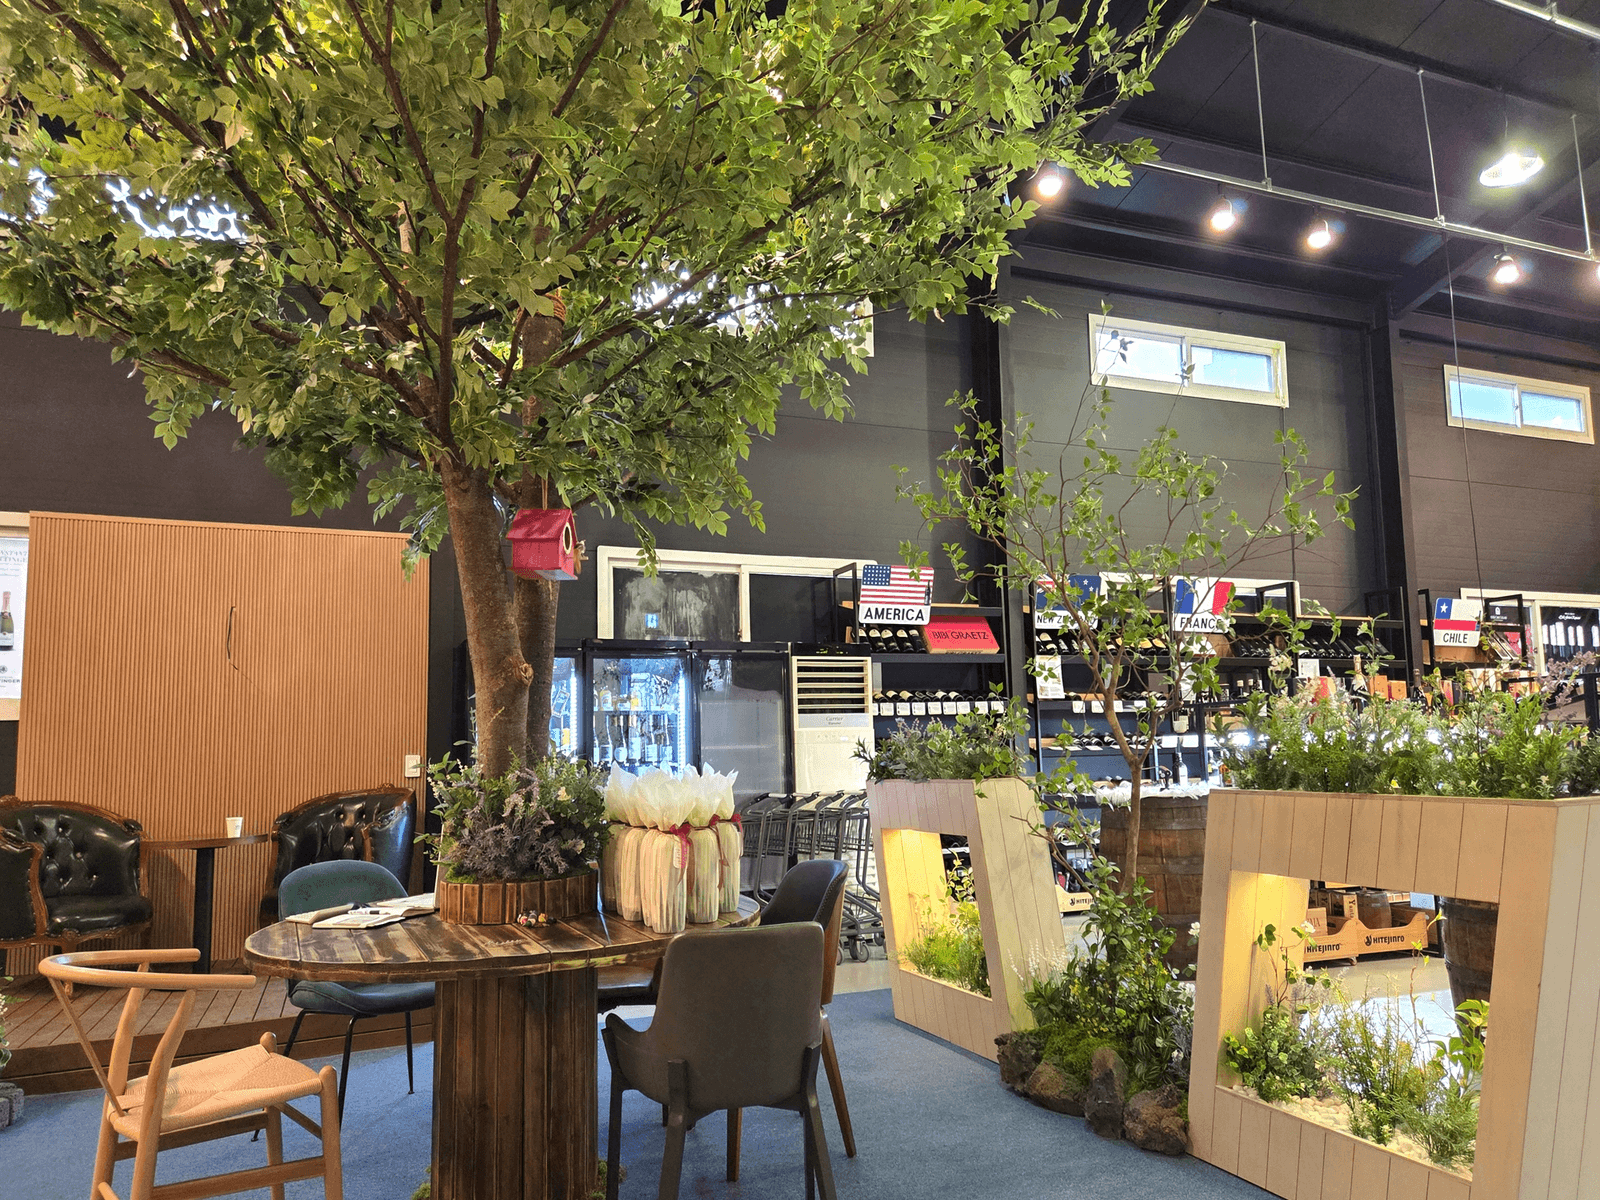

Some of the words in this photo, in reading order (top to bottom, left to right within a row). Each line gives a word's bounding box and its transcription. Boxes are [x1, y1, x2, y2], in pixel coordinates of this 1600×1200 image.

[863, 607, 925, 621] AMERICA
[931, 631, 949, 639] BIBI
[950, 631, 987, 639] GRAETZ
[1442, 632, 1469, 643] CHILE
